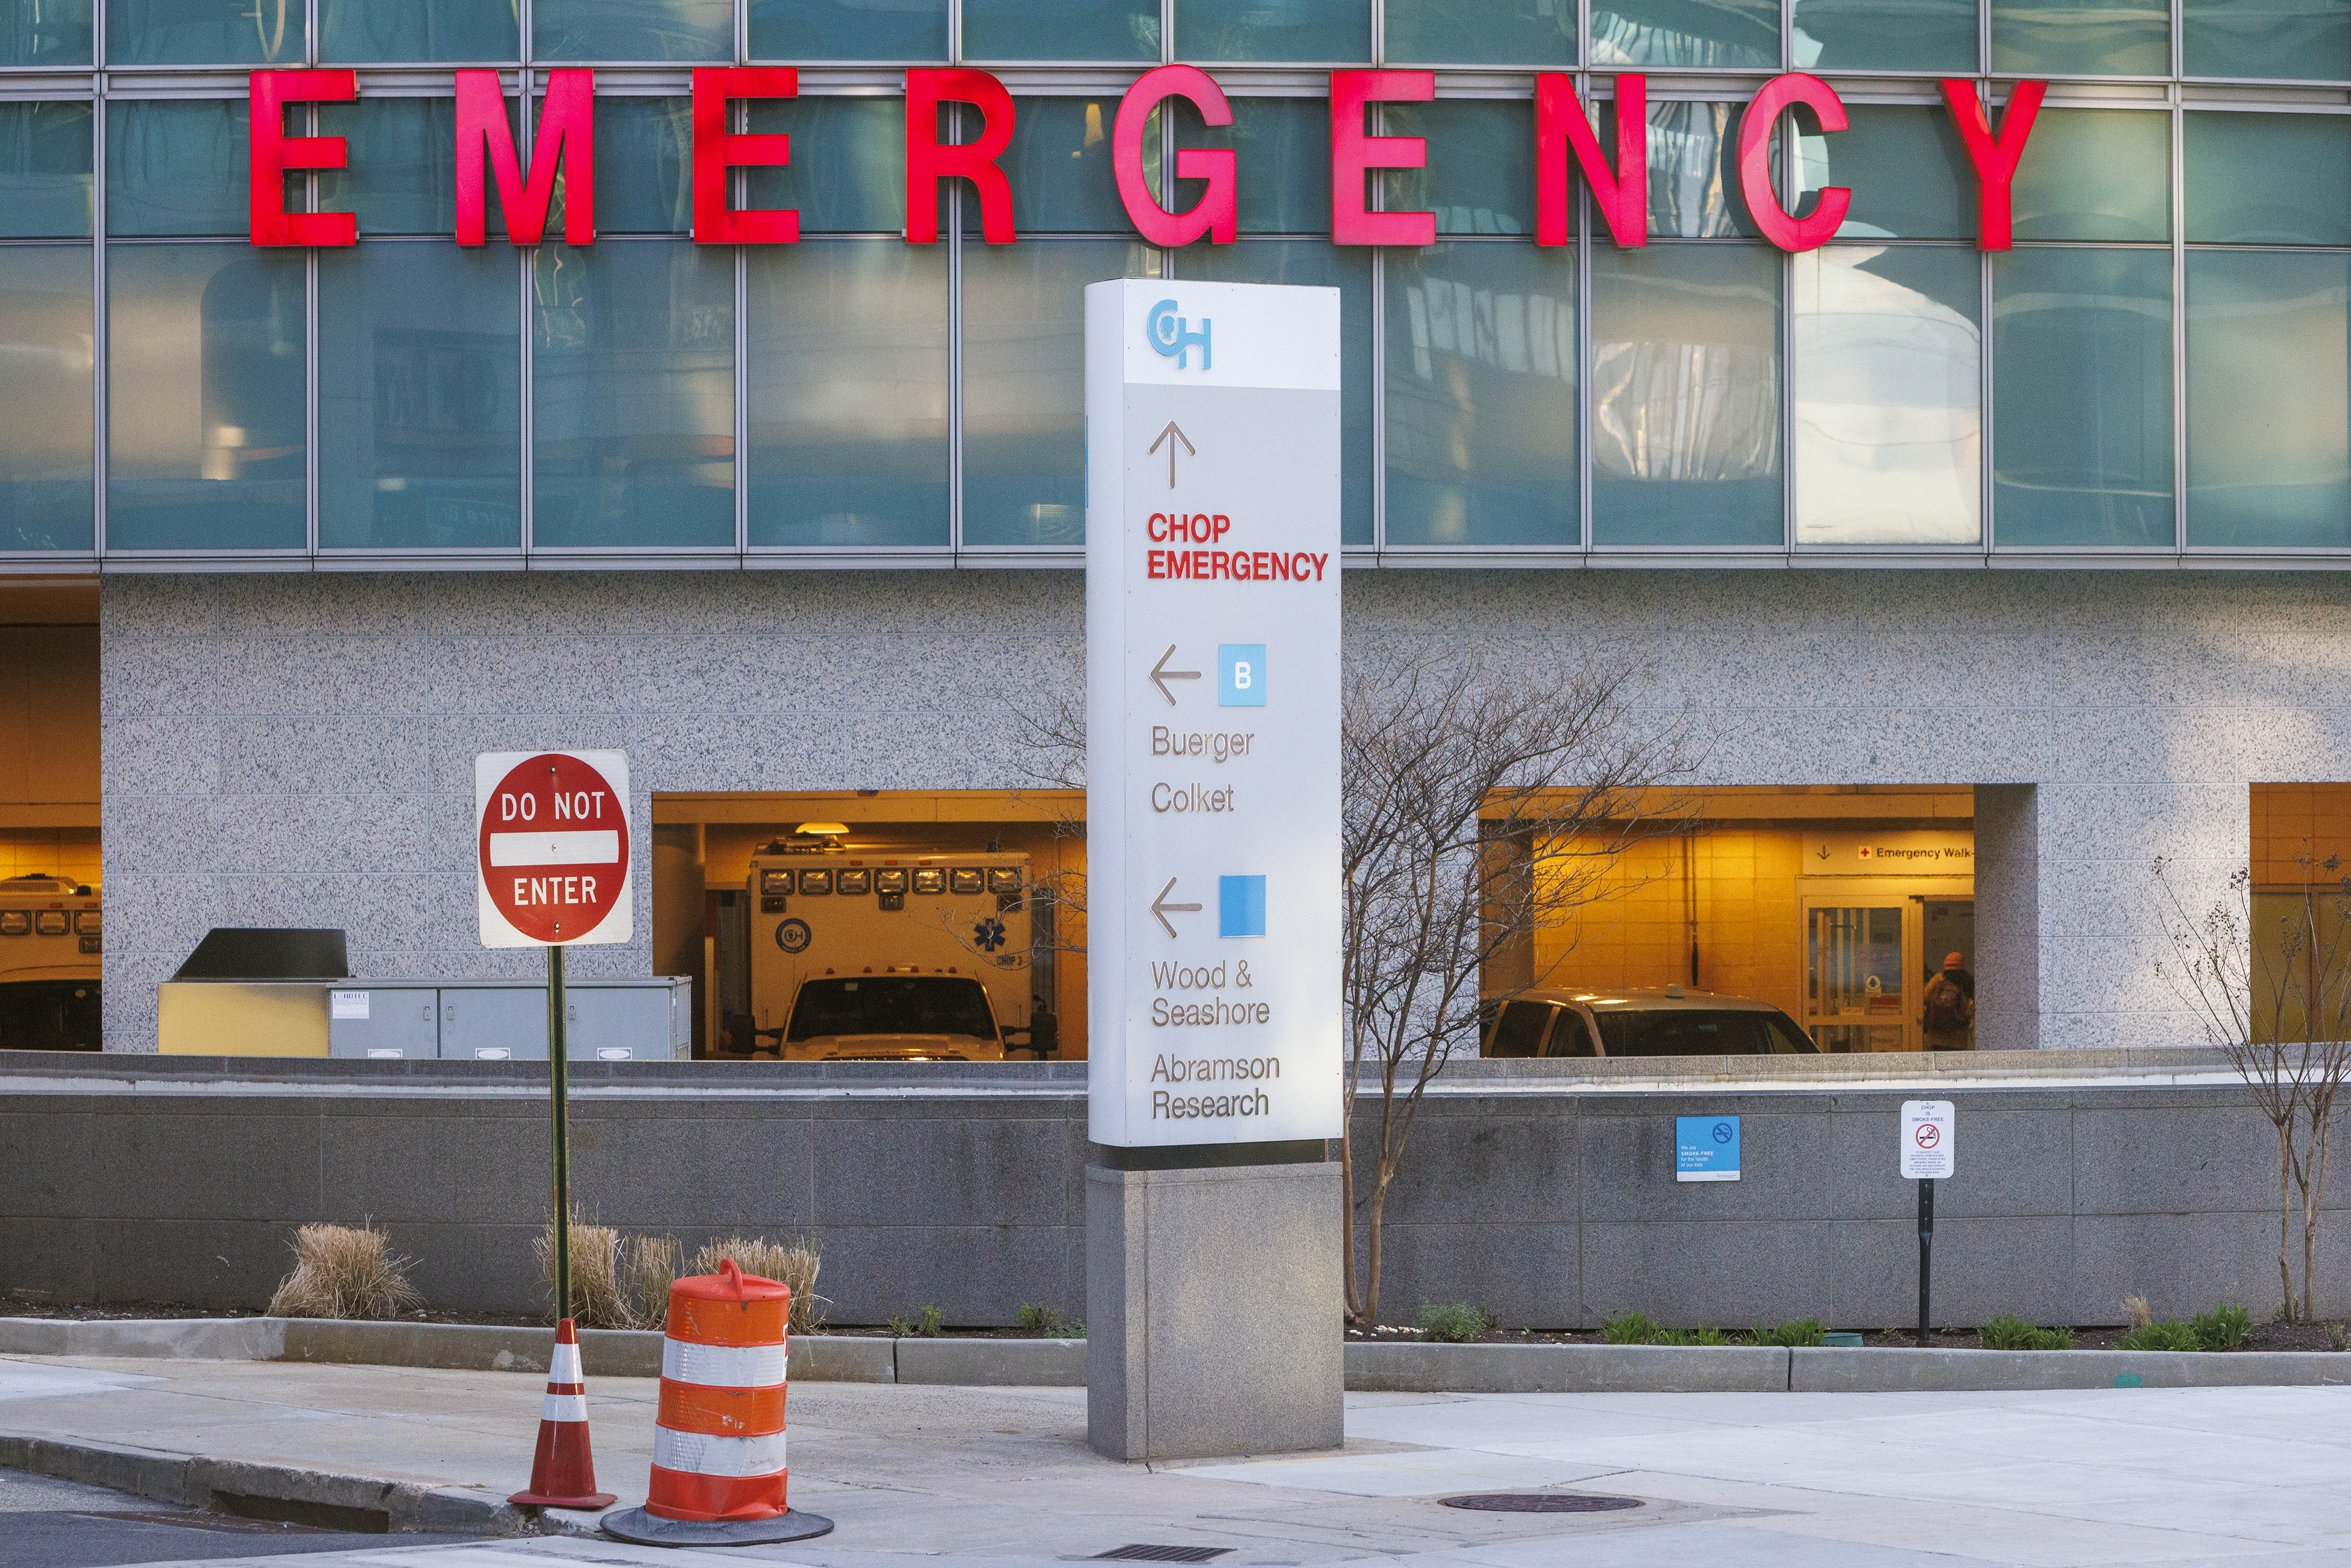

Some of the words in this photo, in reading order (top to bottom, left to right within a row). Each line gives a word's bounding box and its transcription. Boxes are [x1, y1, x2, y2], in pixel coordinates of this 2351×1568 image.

[250, 64, 2048, 252] EMERGENCY
[1148, 512, 1230, 543] CHOP
[1148, 550, 1329, 581] EMERGENCY
[1235, 661, 1251, 690] B
[1151, 725, 1254, 763] Buerger
[502, 792, 536, 820] DO
[555, 792, 605, 819] NOT
[1151, 781, 1235, 813] Colket
[1877, 847, 1940, 860] Emergency
[514, 876, 597, 905] ENTER
[1151, 959, 1226, 990] Wood
[1236, 960, 1253, 989] &
[1151, 997, 1270, 1027] Seashore
[1151, 1054, 1280, 1084] Abramson
[1151, 1088, 1269, 1120] Research
